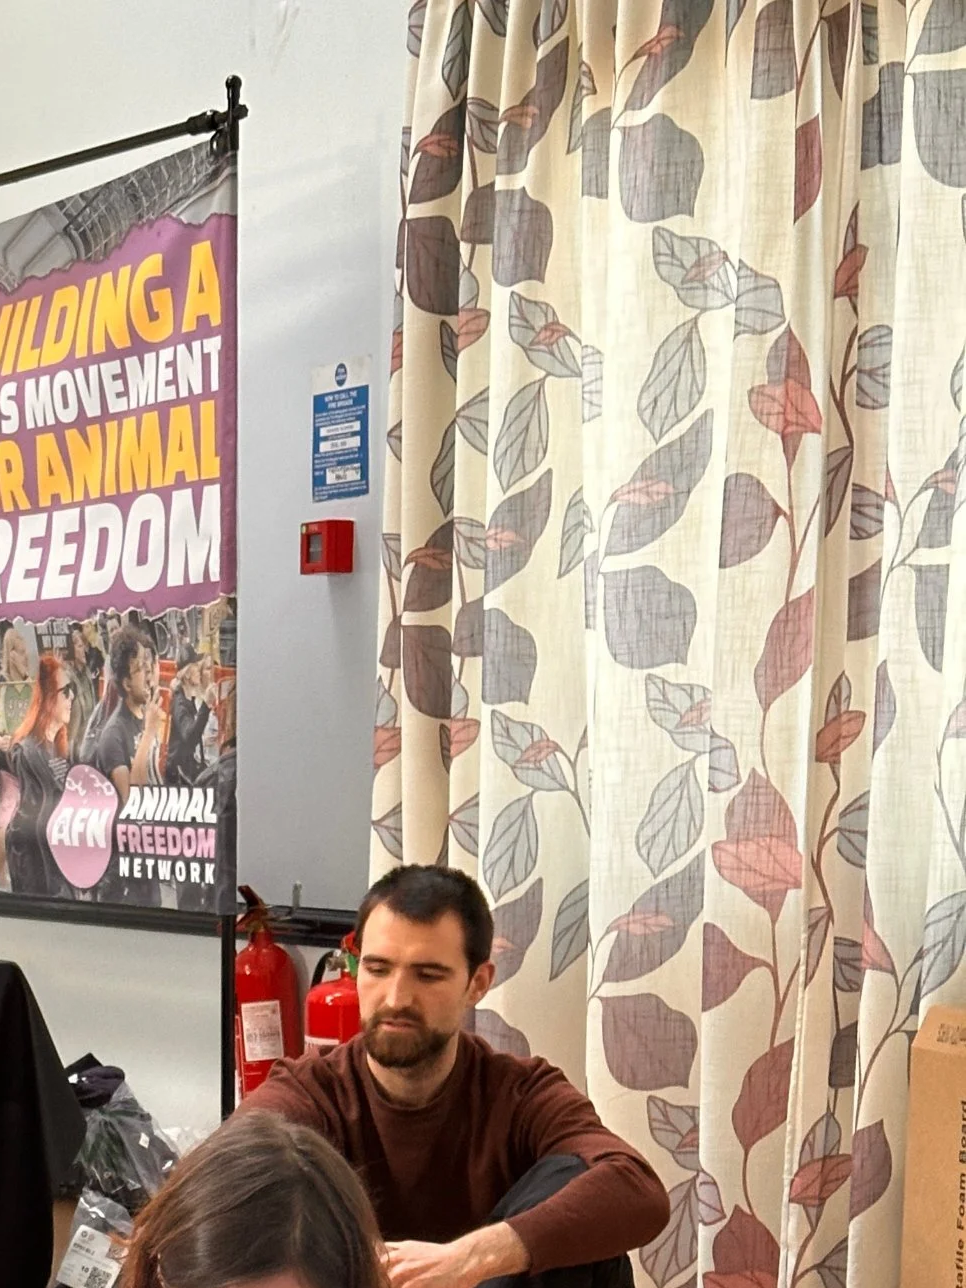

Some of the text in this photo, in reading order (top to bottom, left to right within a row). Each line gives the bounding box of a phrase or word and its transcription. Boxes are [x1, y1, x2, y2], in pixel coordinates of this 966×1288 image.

[181, 240, 222, 333] A
[24, 336, 222, 429] MOVEMENT
[35, 400, 221, 508] ANIMAL
[51, 807, 111, 849] AFN
[119, 786, 218, 823] ANIMAL
[116, 823, 216, 859] FREEDOM
[119, 857, 215, 884] NETWORK
[958, 1100, 966, 1164] Board
[956, 1173, 966, 1230] Foam
